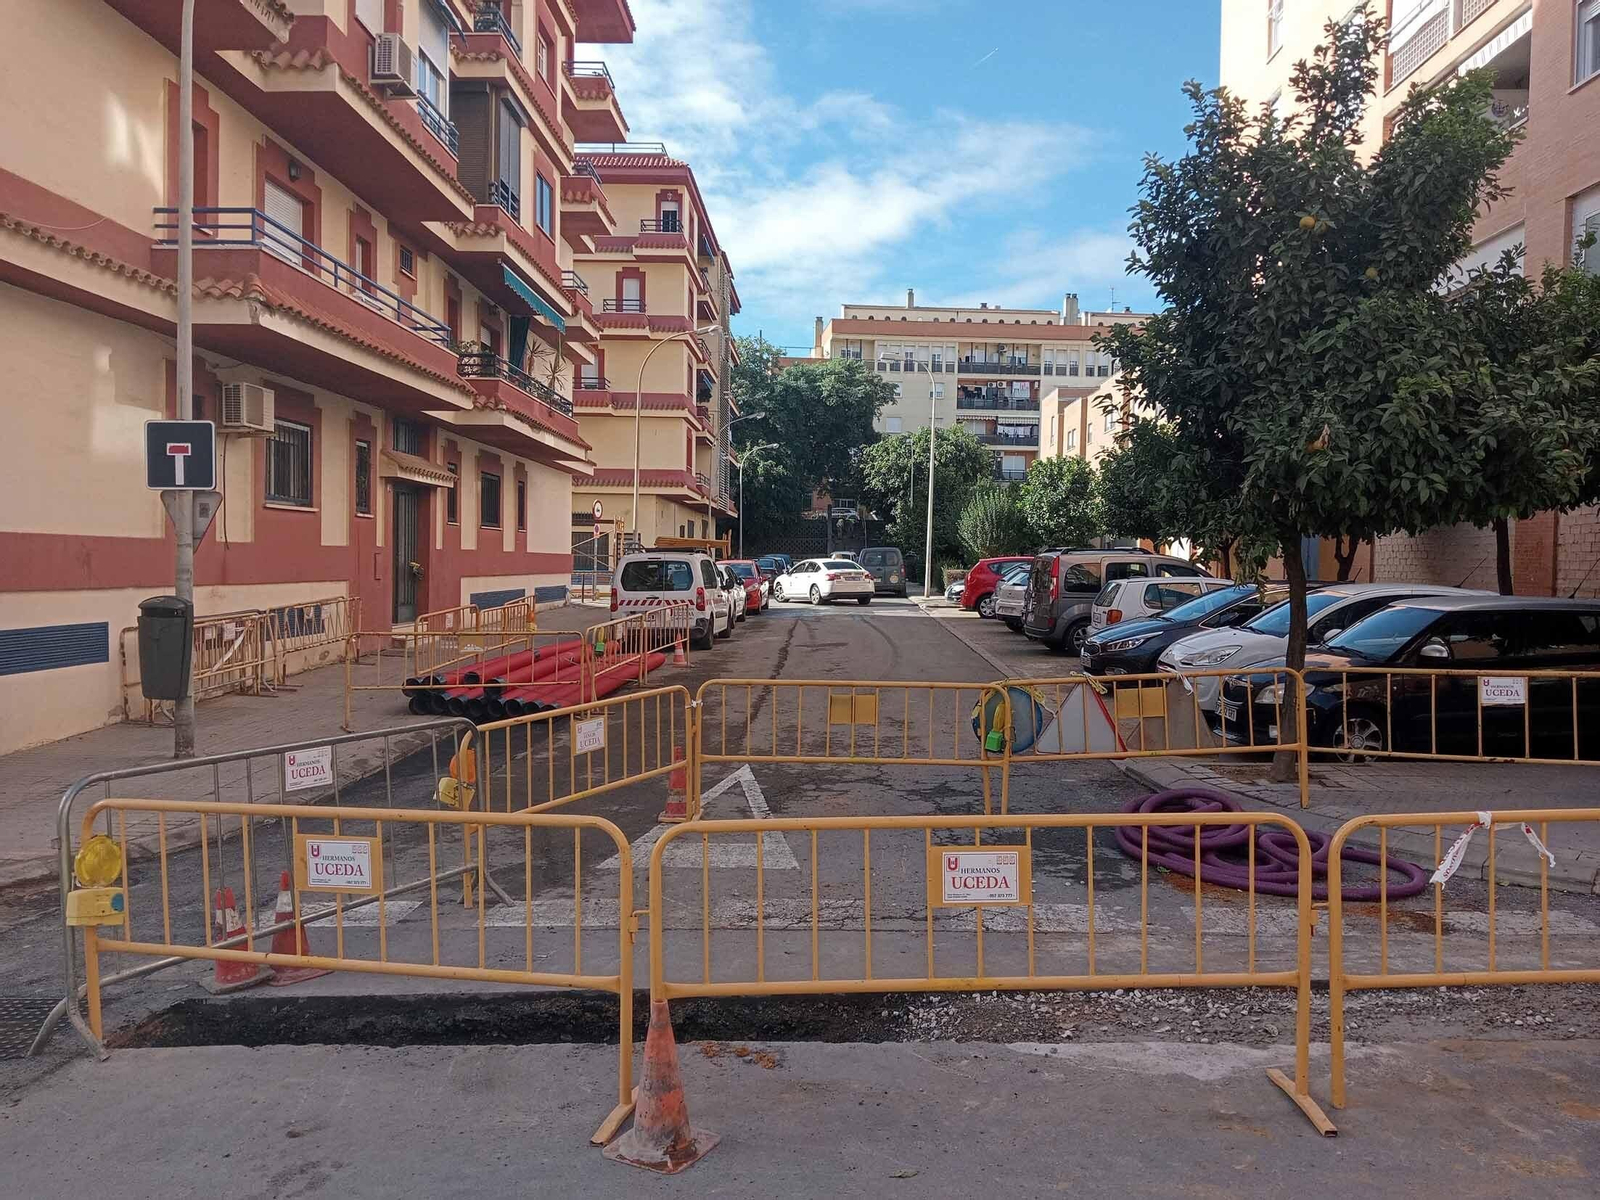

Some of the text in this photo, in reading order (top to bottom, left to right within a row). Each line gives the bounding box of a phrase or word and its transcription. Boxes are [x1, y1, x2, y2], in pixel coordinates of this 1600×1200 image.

[1486, 689, 1520, 697] UCEDA
[291, 765, 326, 780] UCEDA
[315, 863, 364, 876] UCEDA
[951, 876, 1010, 890] UCEDA
